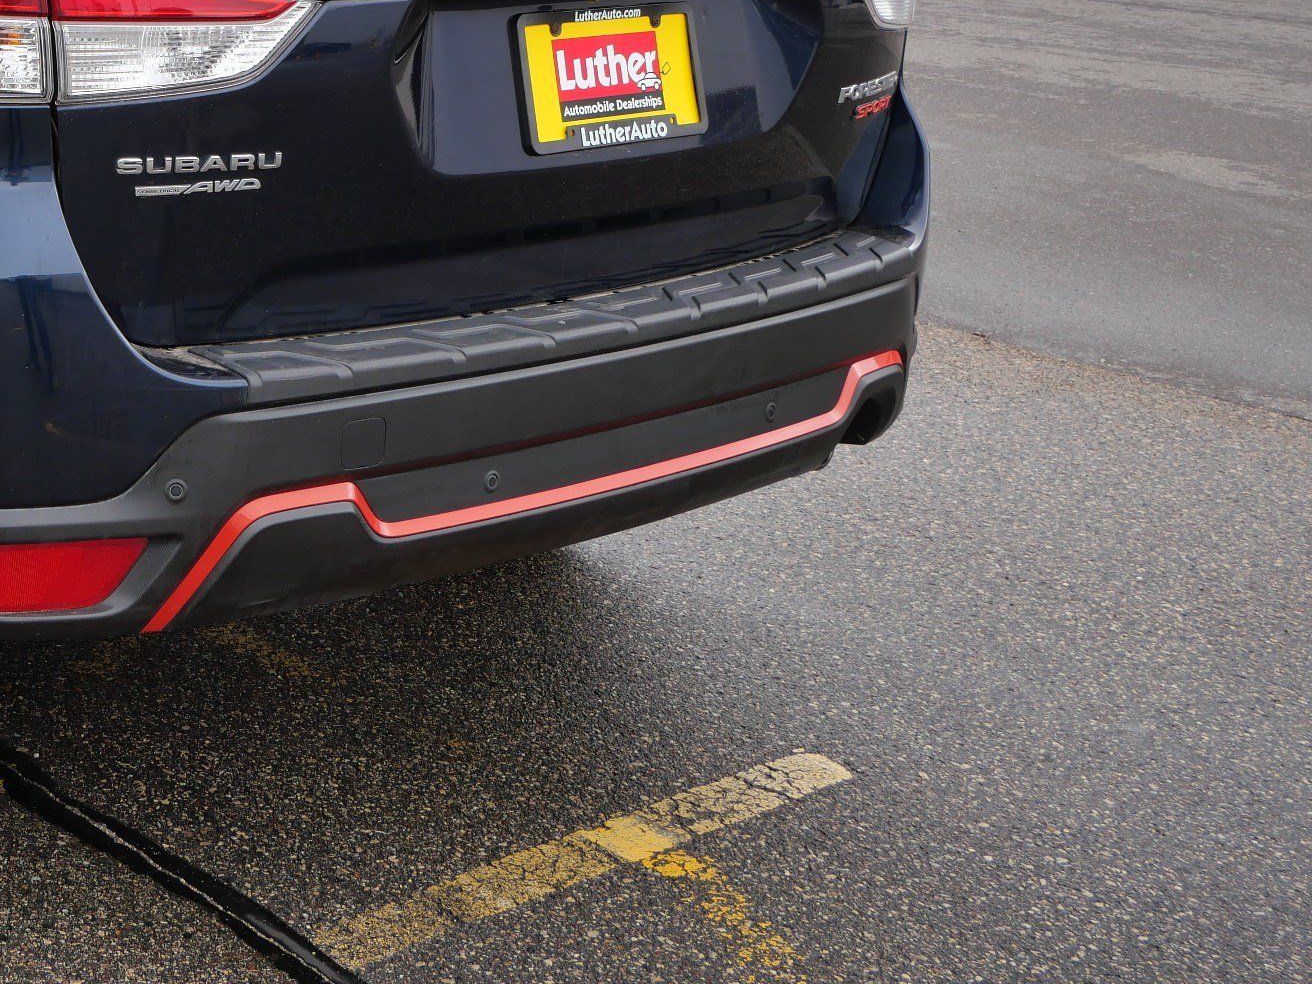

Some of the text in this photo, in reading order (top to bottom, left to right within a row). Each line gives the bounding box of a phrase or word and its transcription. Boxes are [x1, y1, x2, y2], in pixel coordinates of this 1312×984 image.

[574, 8, 641, 23] LutherAuto.com
[555, 44, 657, 91] Luther
[563, 95, 663, 117] Automobile Dealerships
[580, 118, 668, 147] LutherAuto
[115, 152, 283, 175] SUBARU
[183, 177, 262, 195] AWD
